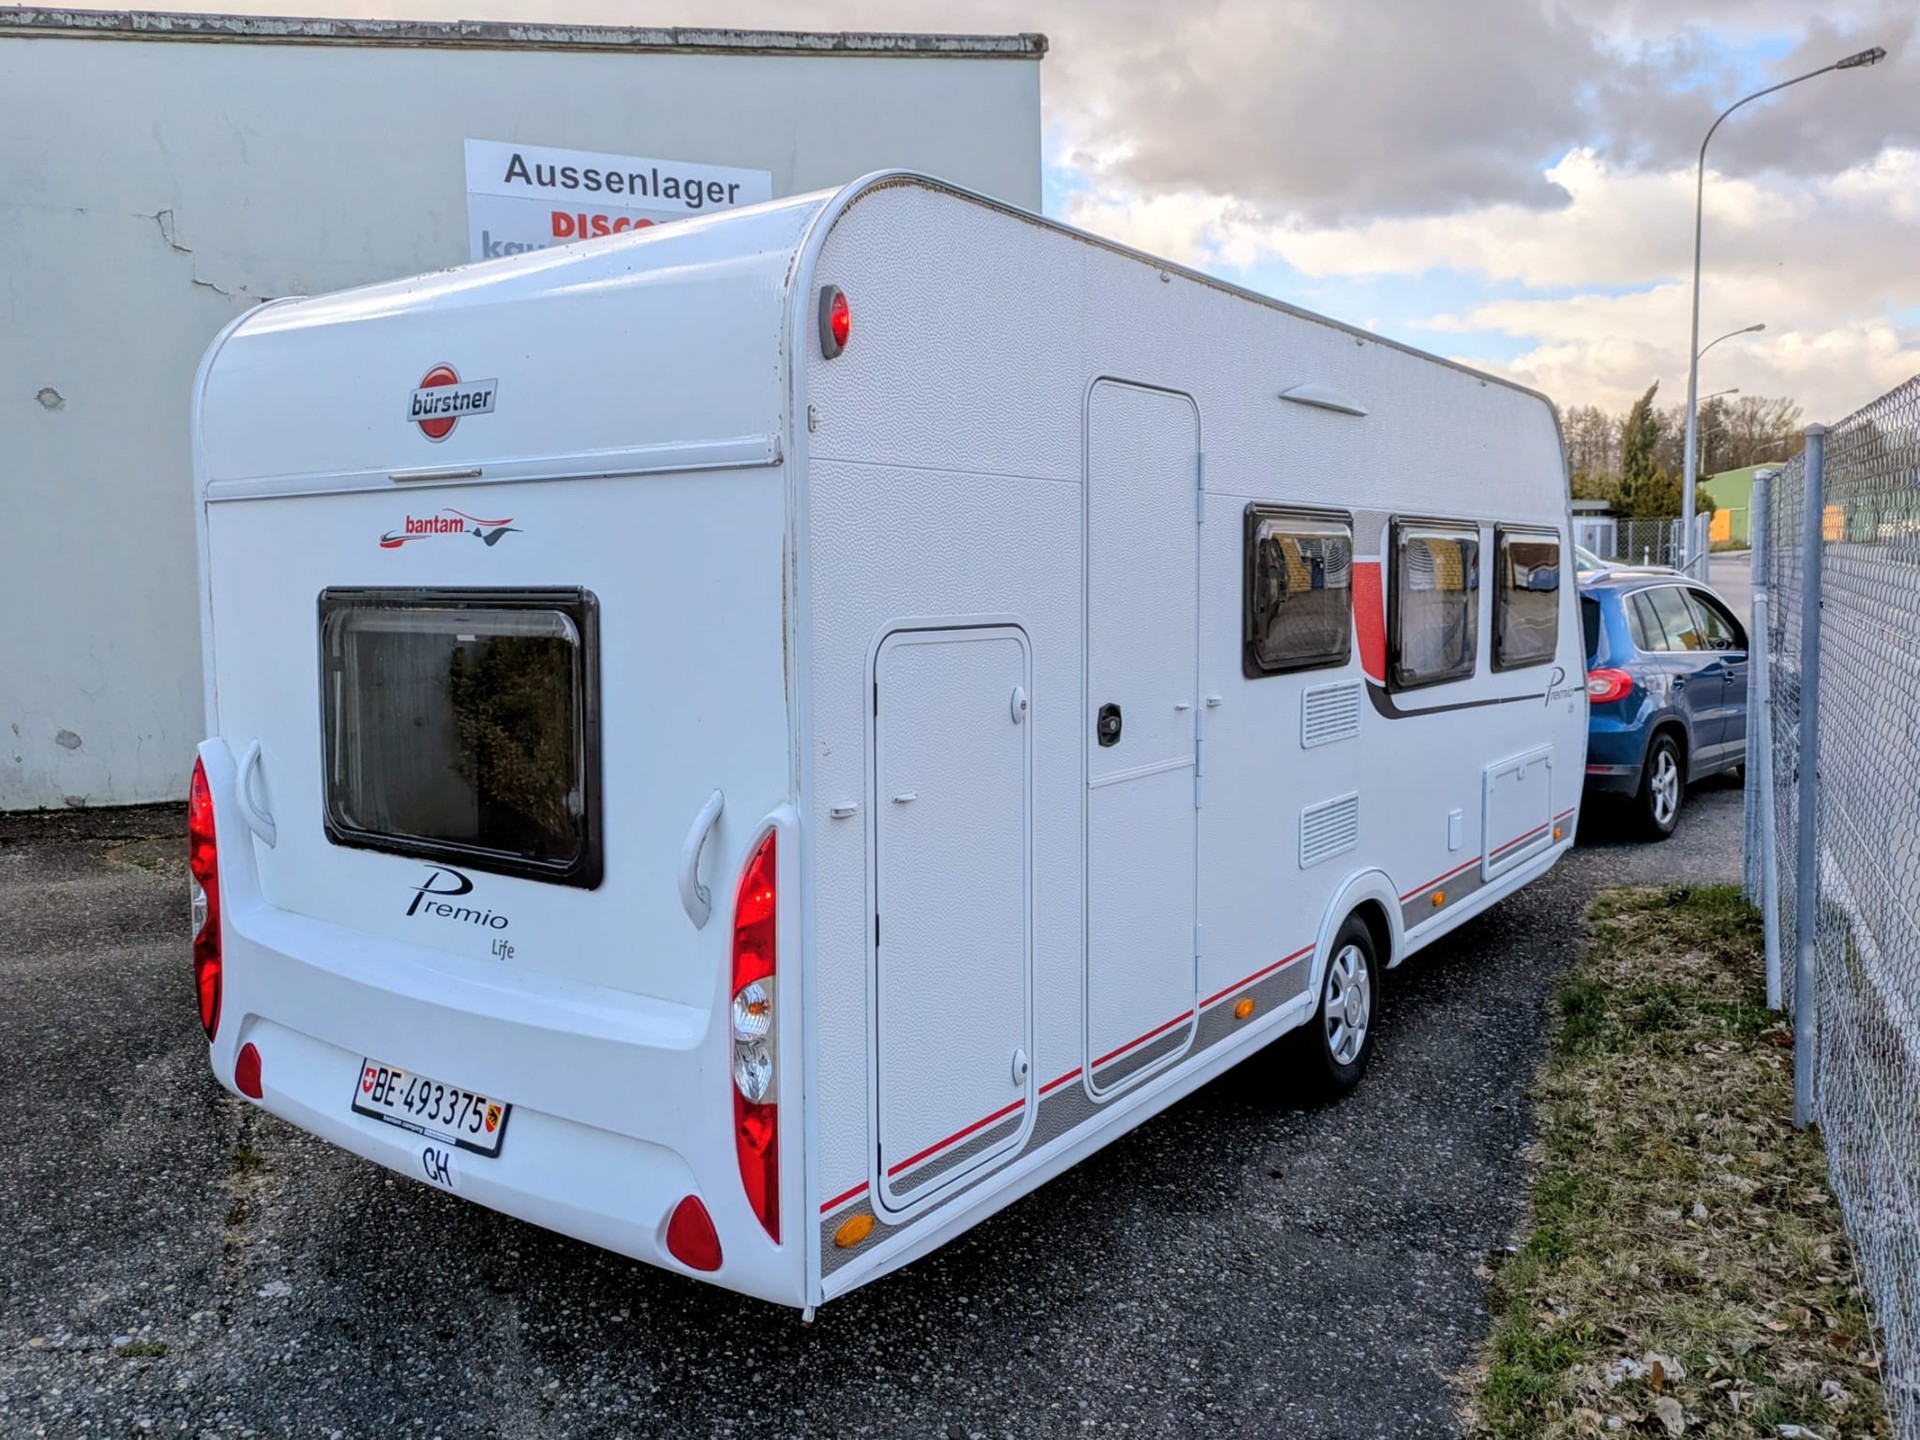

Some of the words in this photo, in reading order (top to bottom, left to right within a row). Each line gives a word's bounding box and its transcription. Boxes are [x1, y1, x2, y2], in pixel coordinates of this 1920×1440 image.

[504, 152, 740, 209] Aussenlager
[411, 389, 492, 416] bürstner
[405, 515, 464, 533] bantam
[406, 864, 509, 929] Premio
[491, 938, 515, 961] Life
[422, 1147, 453, 1187] CH
